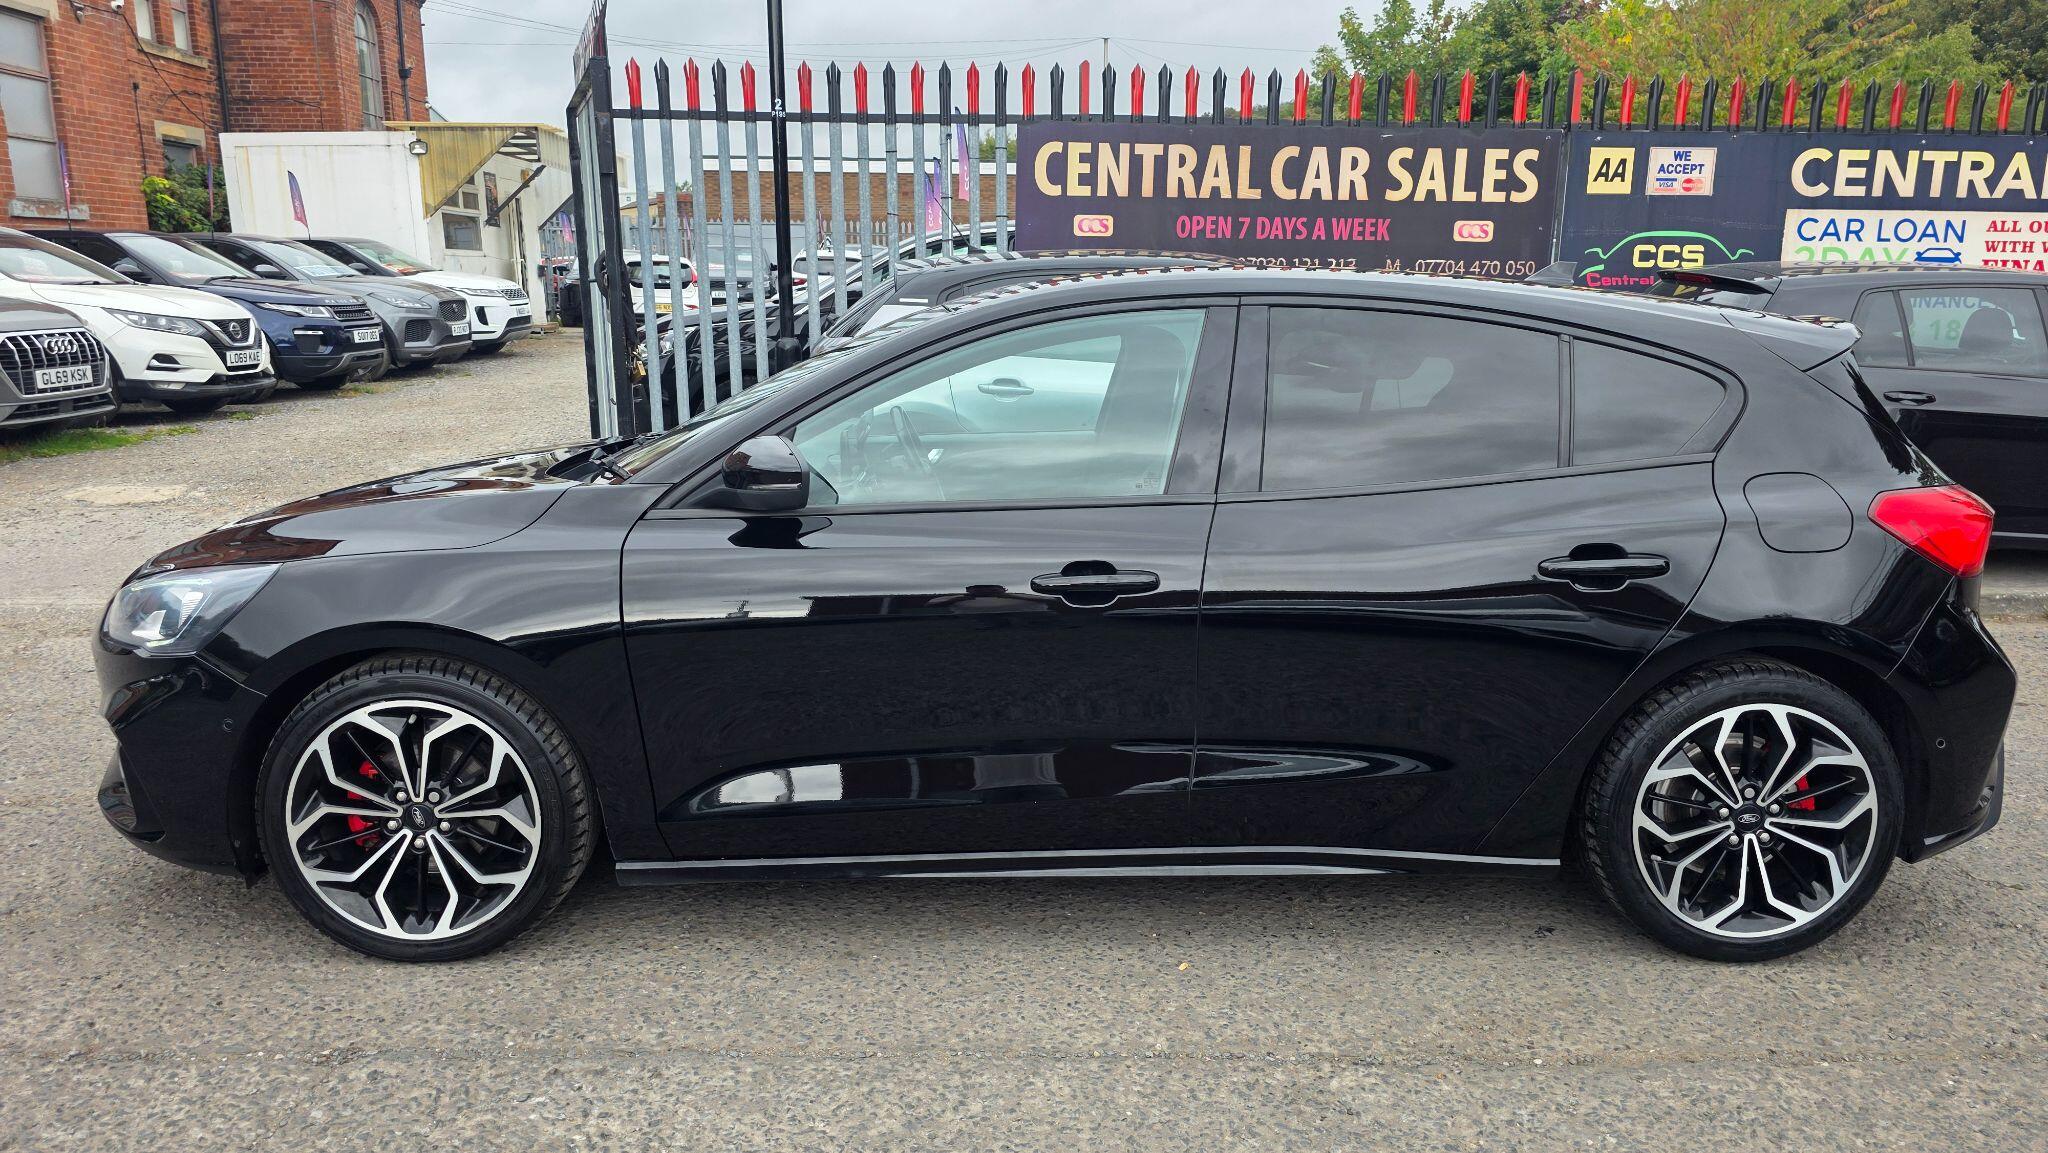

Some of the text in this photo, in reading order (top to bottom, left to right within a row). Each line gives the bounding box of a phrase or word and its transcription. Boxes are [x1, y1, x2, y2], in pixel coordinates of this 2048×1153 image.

[774, 98, 782, 111] 2
[1673, 150, 1692, 162] WE
[1034, 141, 1262, 199] CENTRAL
[1270, 145, 1371, 201] CAR
[1384, 147, 1540, 203] SALES
[1593, 157, 1628, 183] AA
[1657, 163, 1705, 175] ACCEPT
[1791, 147, 2048, 200] CENTRA
[1176, 215, 1391, 242] OPEN 7 DAYS A WEEK
[1796, 217, 1967, 243] CAR LOAN
[1986, 219, 2022, 233] ALL
[1984, 240, 2036, 253] WITH
[1632, 244, 1705, 269] CCS
[1415, 259, 1465, 275] 07704
[1469, 260, 1500, 275] 470
[1505, 260, 1535, 276] 050
[1586, 272, 1655, 287] Central
[41, 367, 89, 385] GL69 KSK
